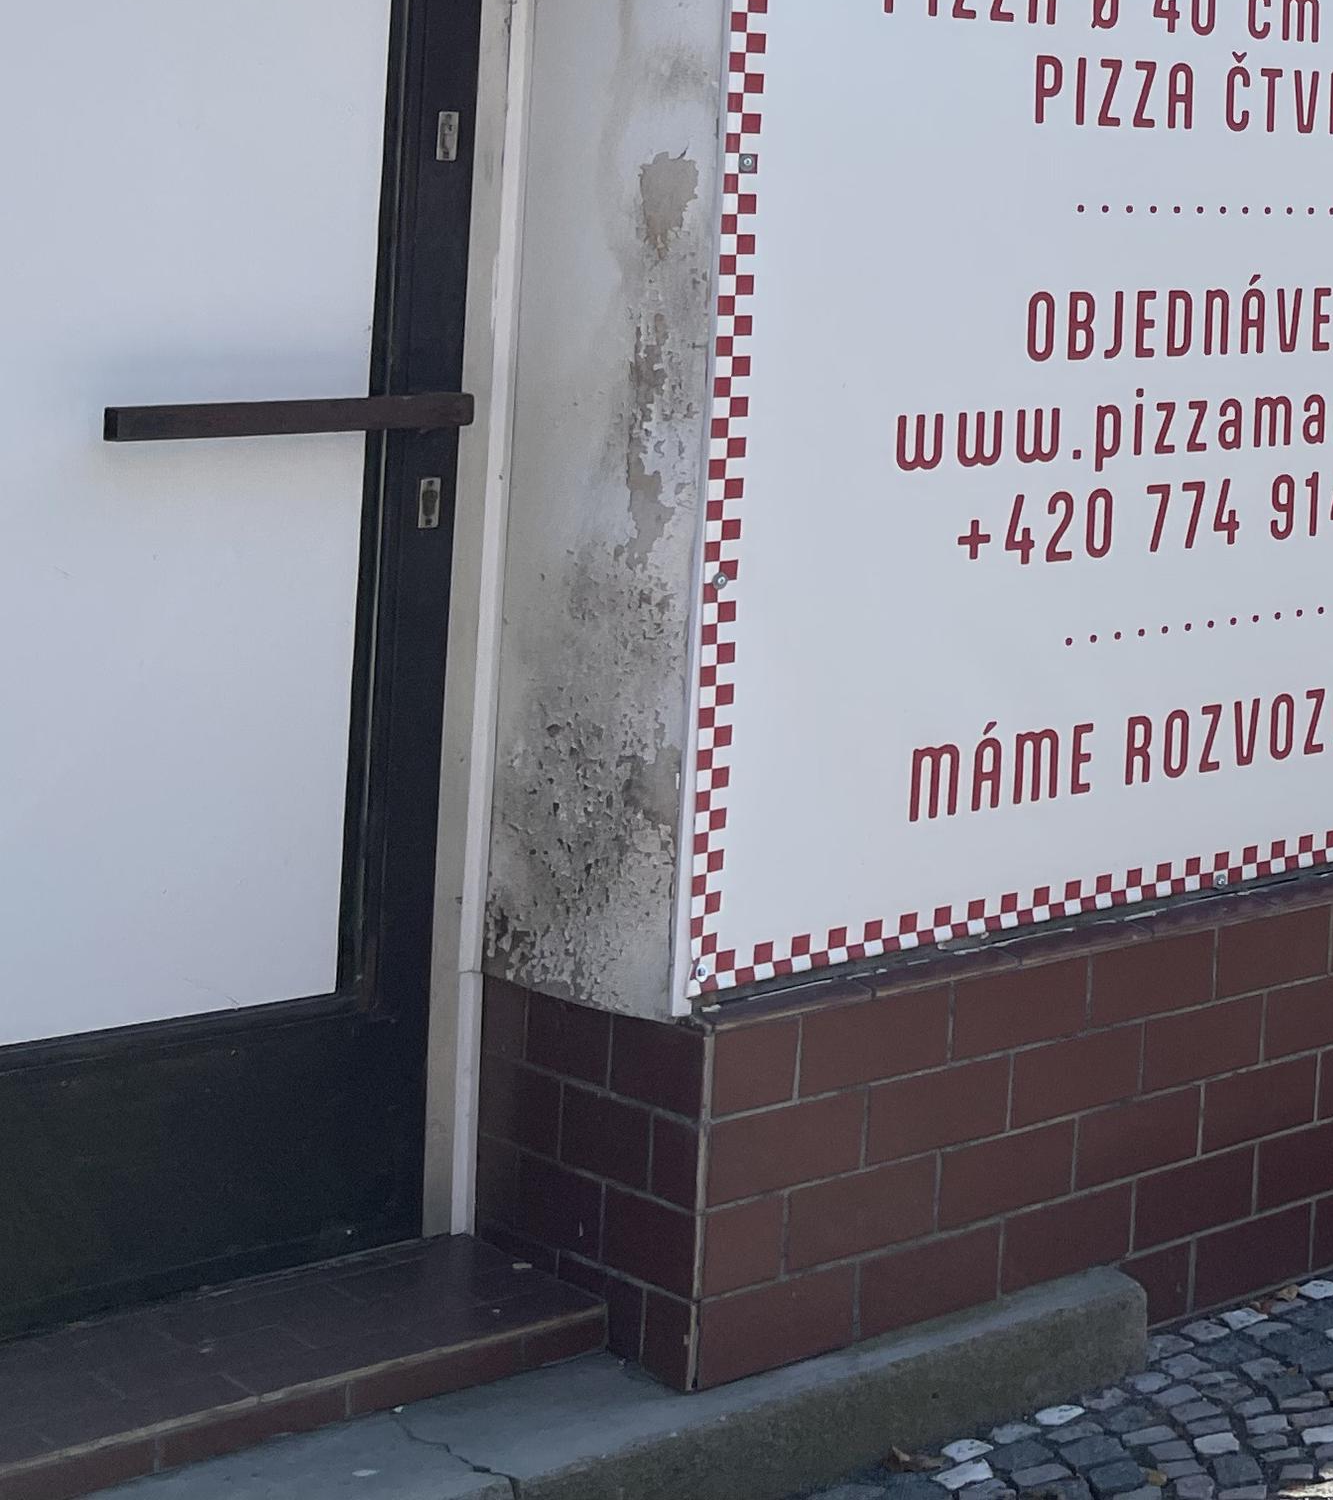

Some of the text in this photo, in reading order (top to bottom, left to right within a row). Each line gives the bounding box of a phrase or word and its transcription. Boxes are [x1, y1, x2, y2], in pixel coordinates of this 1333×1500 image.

[1033, 54, 1195, 131] PIZZA
[956, 488, 1114, 566] +420
[1144, 478, 1239, 554] 774
[908, 721, 1093, 824] MÁME
